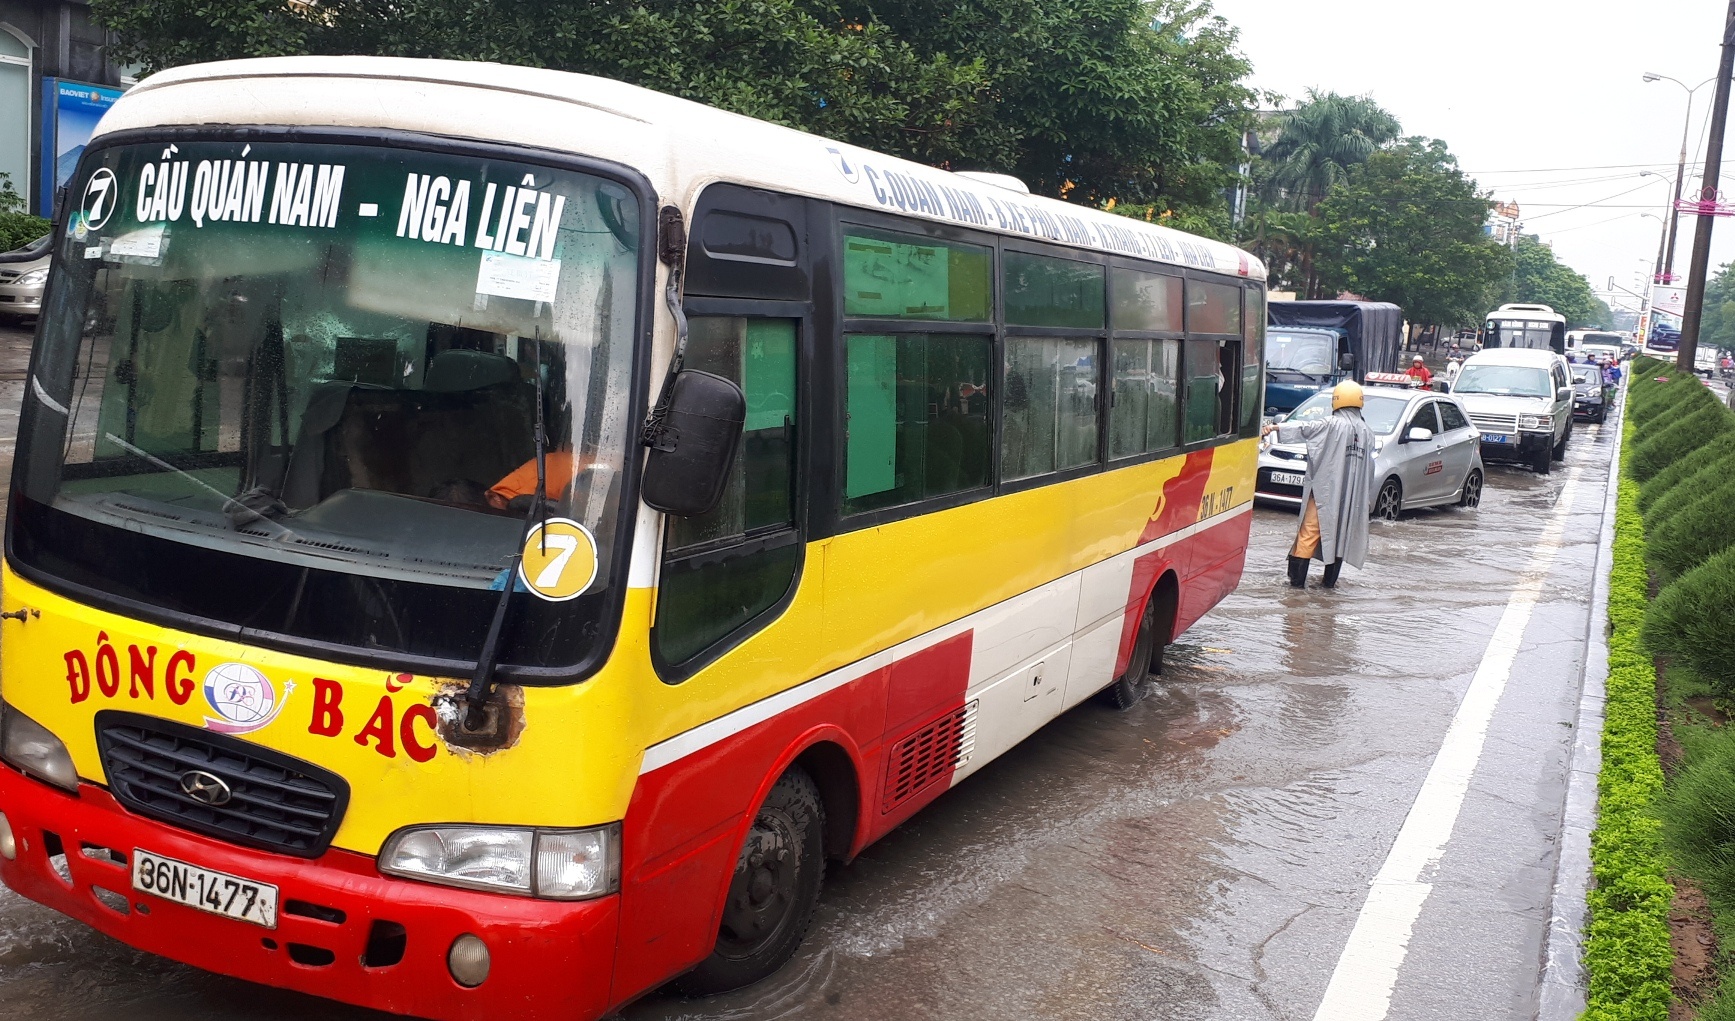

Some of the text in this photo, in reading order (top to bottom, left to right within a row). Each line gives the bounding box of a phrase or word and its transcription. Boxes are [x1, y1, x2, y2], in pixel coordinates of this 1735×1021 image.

[60, 88, 89, 98] BAOVIET
[86, 174, 115, 224] 7
[136, 144, 190, 223] CẦU
[190, 144, 269, 228] QUÁN
[268, 162, 346, 228] NAM
[396, 172, 471, 247] NGA
[474, 173, 566, 262] LIÊN
[938, 184, 988, 226] NAM
[1055, 213, 1092, 246] NAM
[1379, 373, 1407, 383] TAXI
[1200, 492, 1215, 519] 36N
[534, 533, 578, 589] 7
[64, 630, 437, 763] ĐÔNG BẮC
[139, 857, 260, 918] 36N-1477
